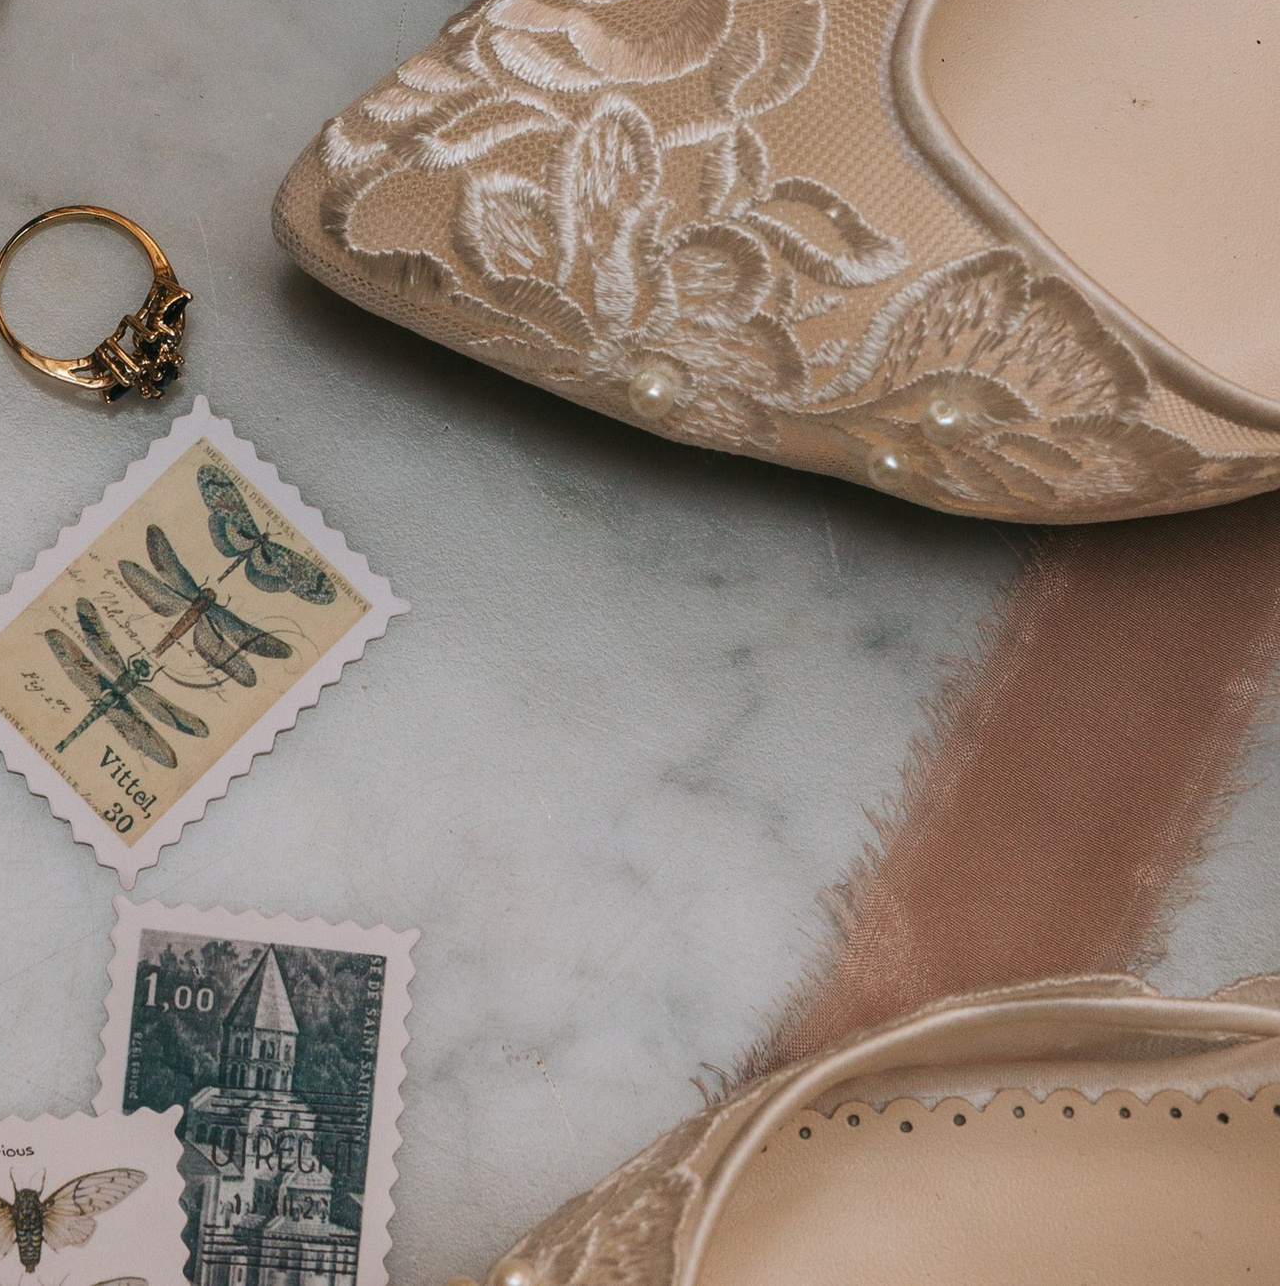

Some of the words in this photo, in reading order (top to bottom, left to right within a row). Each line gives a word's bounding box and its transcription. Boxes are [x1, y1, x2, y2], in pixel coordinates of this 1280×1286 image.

[99, 745, 158, 820] Vittel,
[103, 802, 135, 834] 30
[142, 971, 215, 1013] 1,00
[366, 980, 381, 1001] DE
[210, 1131, 363, 1177] UTRECHT
